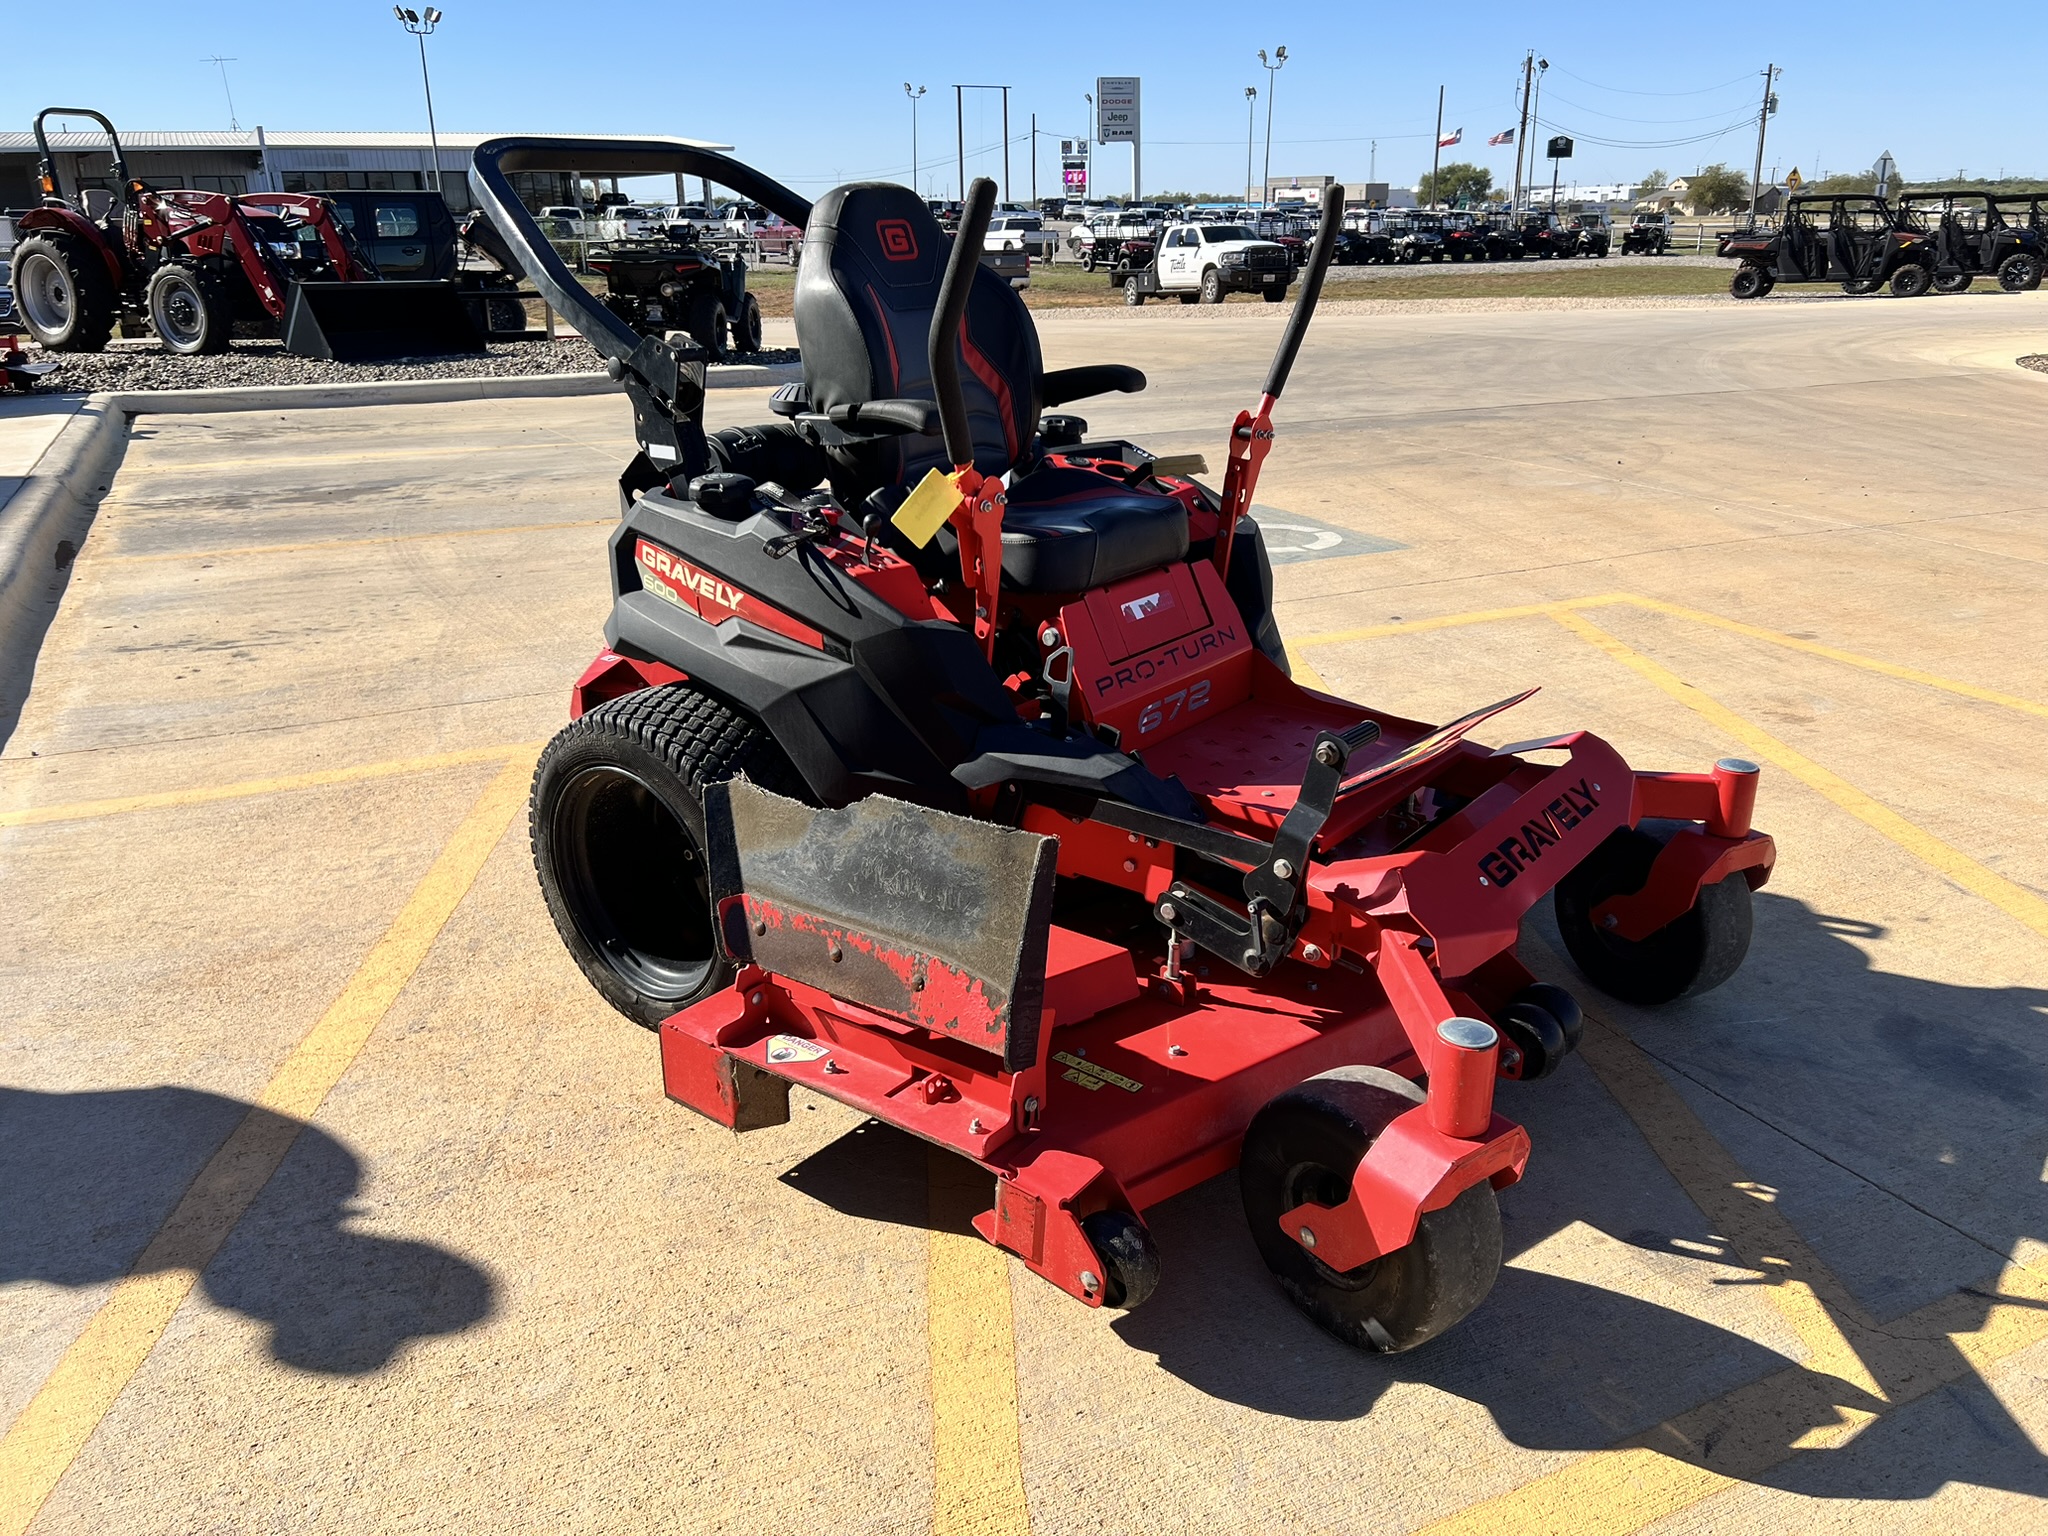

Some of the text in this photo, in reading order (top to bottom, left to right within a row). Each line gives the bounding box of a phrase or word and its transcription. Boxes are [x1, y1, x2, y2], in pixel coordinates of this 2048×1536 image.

[1107, 111, 1129, 123] Jeep
[642, 544, 744, 611] GRAVELY
[643, 574, 678, 602] 600
[1095, 625, 1236, 698] PRO-TURN
[1138, 679, 1211, 734] 672
[1478, 778, 1600, 888] GRAVELY
